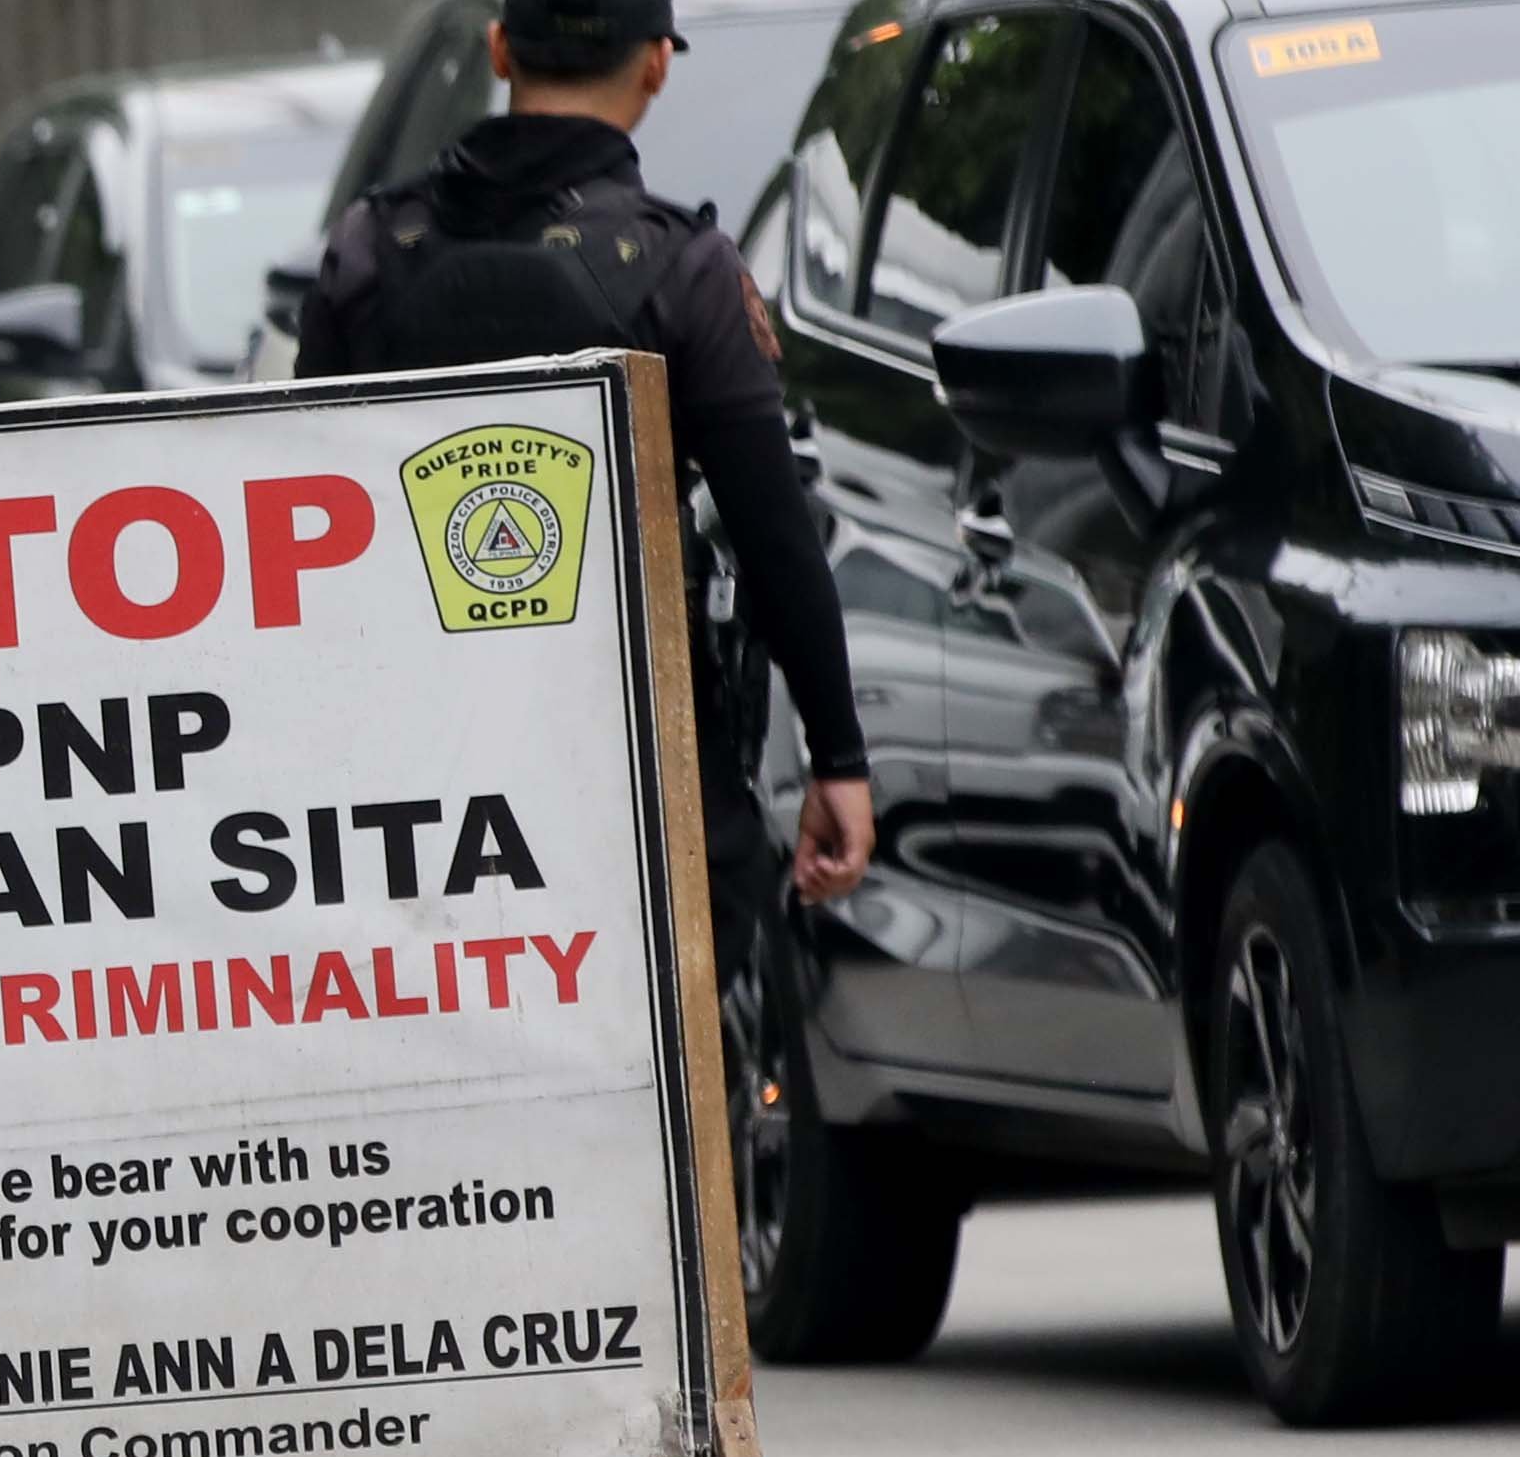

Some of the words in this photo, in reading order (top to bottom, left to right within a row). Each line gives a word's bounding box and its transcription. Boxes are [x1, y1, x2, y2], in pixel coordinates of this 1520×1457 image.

[415, 440, 503, 480] QUEZON
[511, 439, 581, 468] CITY'S
[461, 459, 538, 479] PRIDE
[457, 491, 485, 519] CITY
[489, 485, 540, 507] POLICE
[450, 521, 476, 578] QUEZON
[536, 507, 557, 574] DISTRICT
[489, 577, 524, 590] 1939
[467, 597, 549, 622] QCPD
[210, 794, 546, 912] SITA
[51, 1154, 172, 1199] bear
[190, 1137, 308, 1188] with
[329, 1142, 390, 1178] us
[88, 1212, 208, 1266] your
[226, 1183, 554, 1247] cooperation
[114, 1337, 235, 1397] ANN
[256, 1333, 296, 1386] A
[313, 1320, 465, 1381] DELA
[483, 1306, 641, 1368] CRUZ
